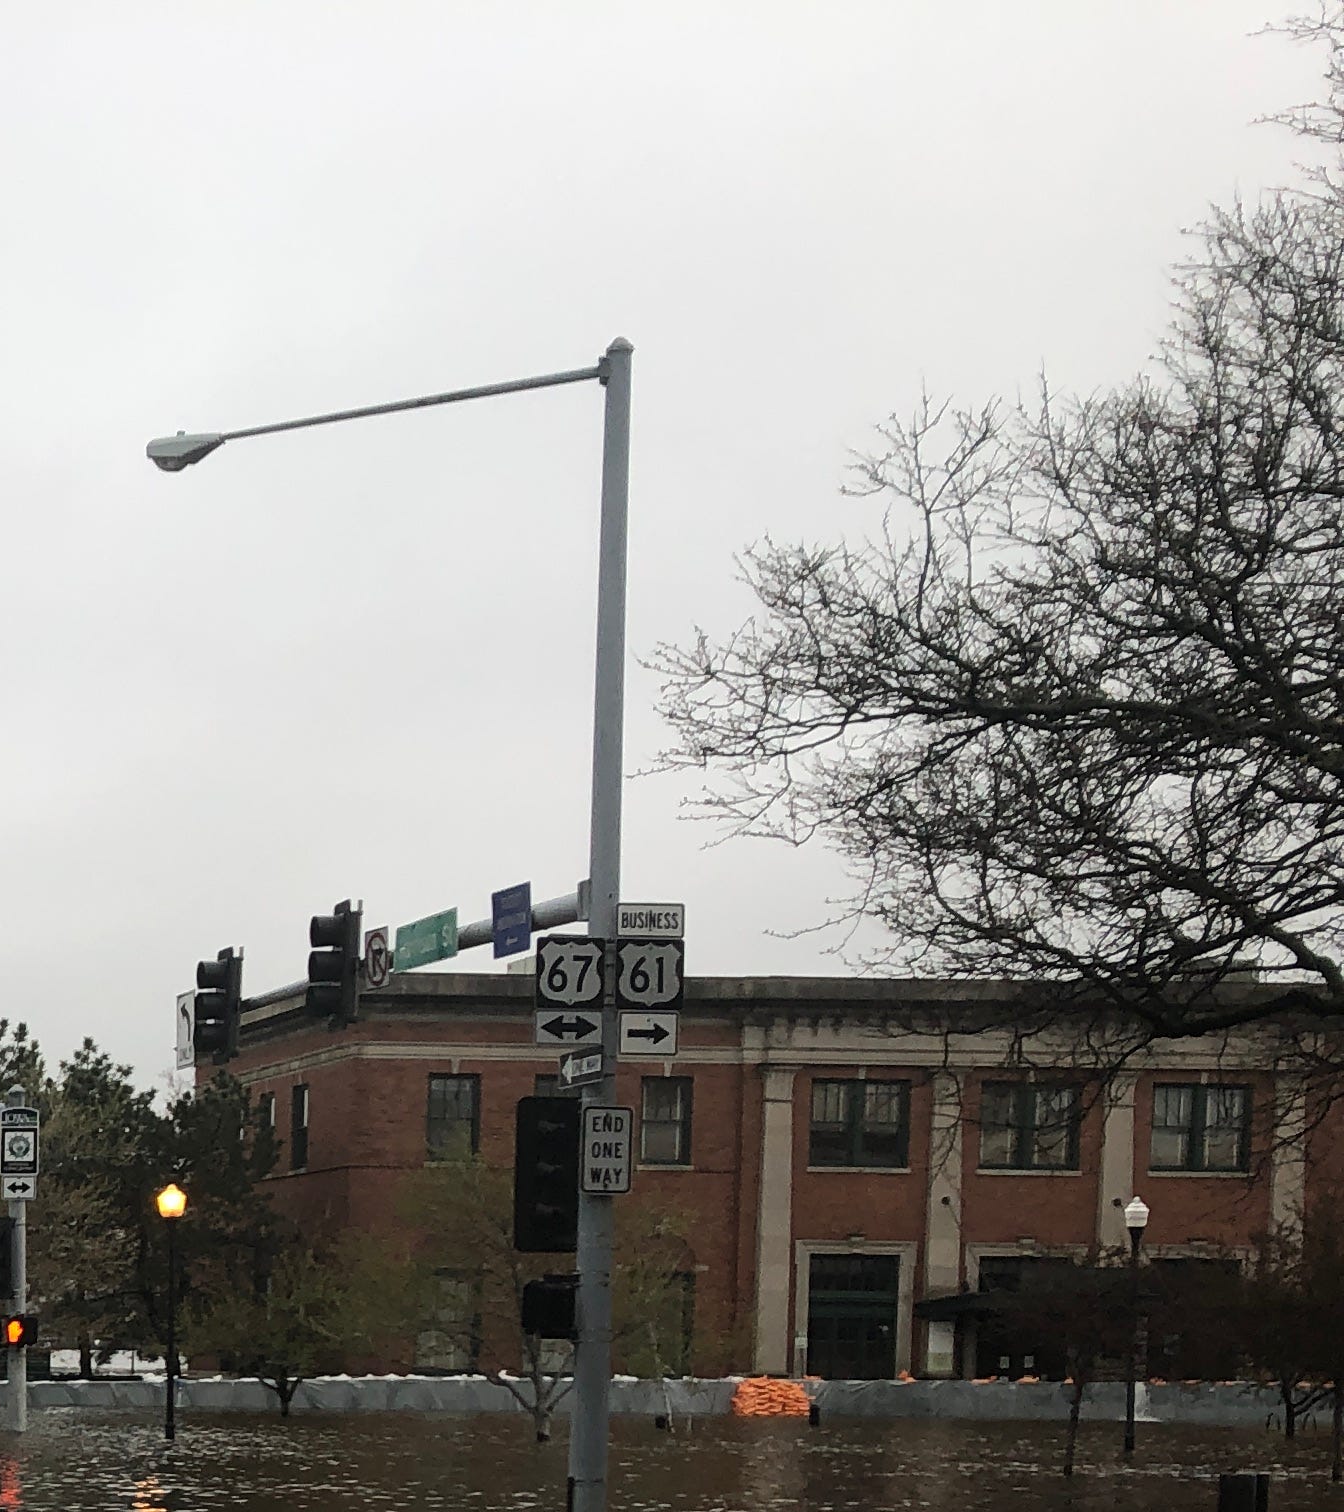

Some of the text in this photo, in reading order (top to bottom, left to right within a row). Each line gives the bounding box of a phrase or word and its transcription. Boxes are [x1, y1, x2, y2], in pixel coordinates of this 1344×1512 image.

[621, 912, 679, 931] BUSINESS
[547, 955, 593, 993] 67
[629, 956, 664, 994] 61
[592, 1115, 624, 1133] END
[591, 1141, 624, 1159] ONE
[590, 1167, 623, 1185] WAY
